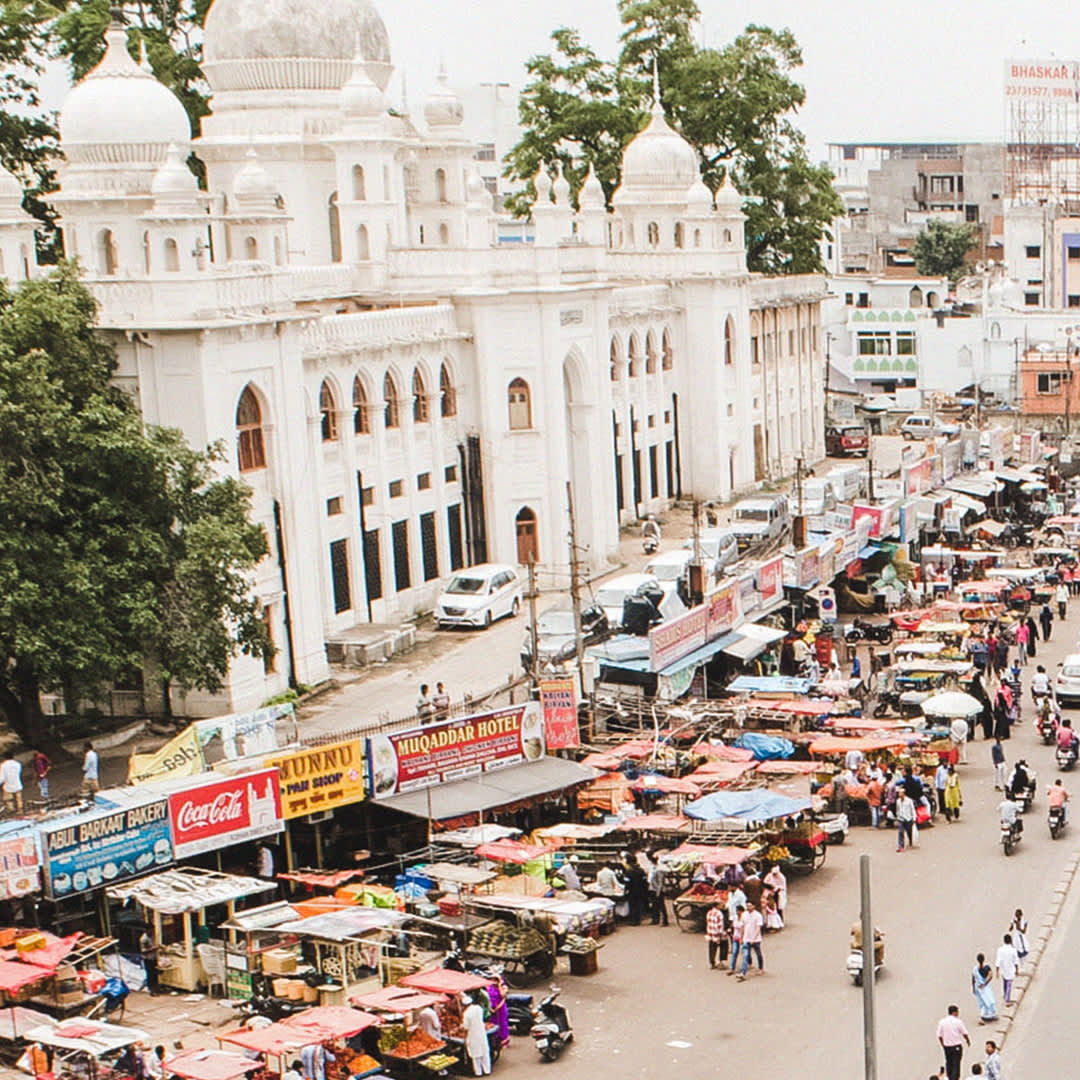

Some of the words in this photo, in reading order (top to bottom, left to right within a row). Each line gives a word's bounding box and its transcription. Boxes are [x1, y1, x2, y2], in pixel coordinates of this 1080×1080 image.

[1011, 64, 1068, 79] BHASKAR
[398, 724, 475, 756] MUQADDAR
[478, 714, 520, 735] HOTEL
[272, 745, 353, 781] MUNNU
[287, 780, 309, 796] PAN
[312, 772, 343, 790] SHOP
[50, 827, 77, 850] ABUL
[80, 812, 126, 842] BARKAAT
[127, 799, 168, 828] BAKERY
